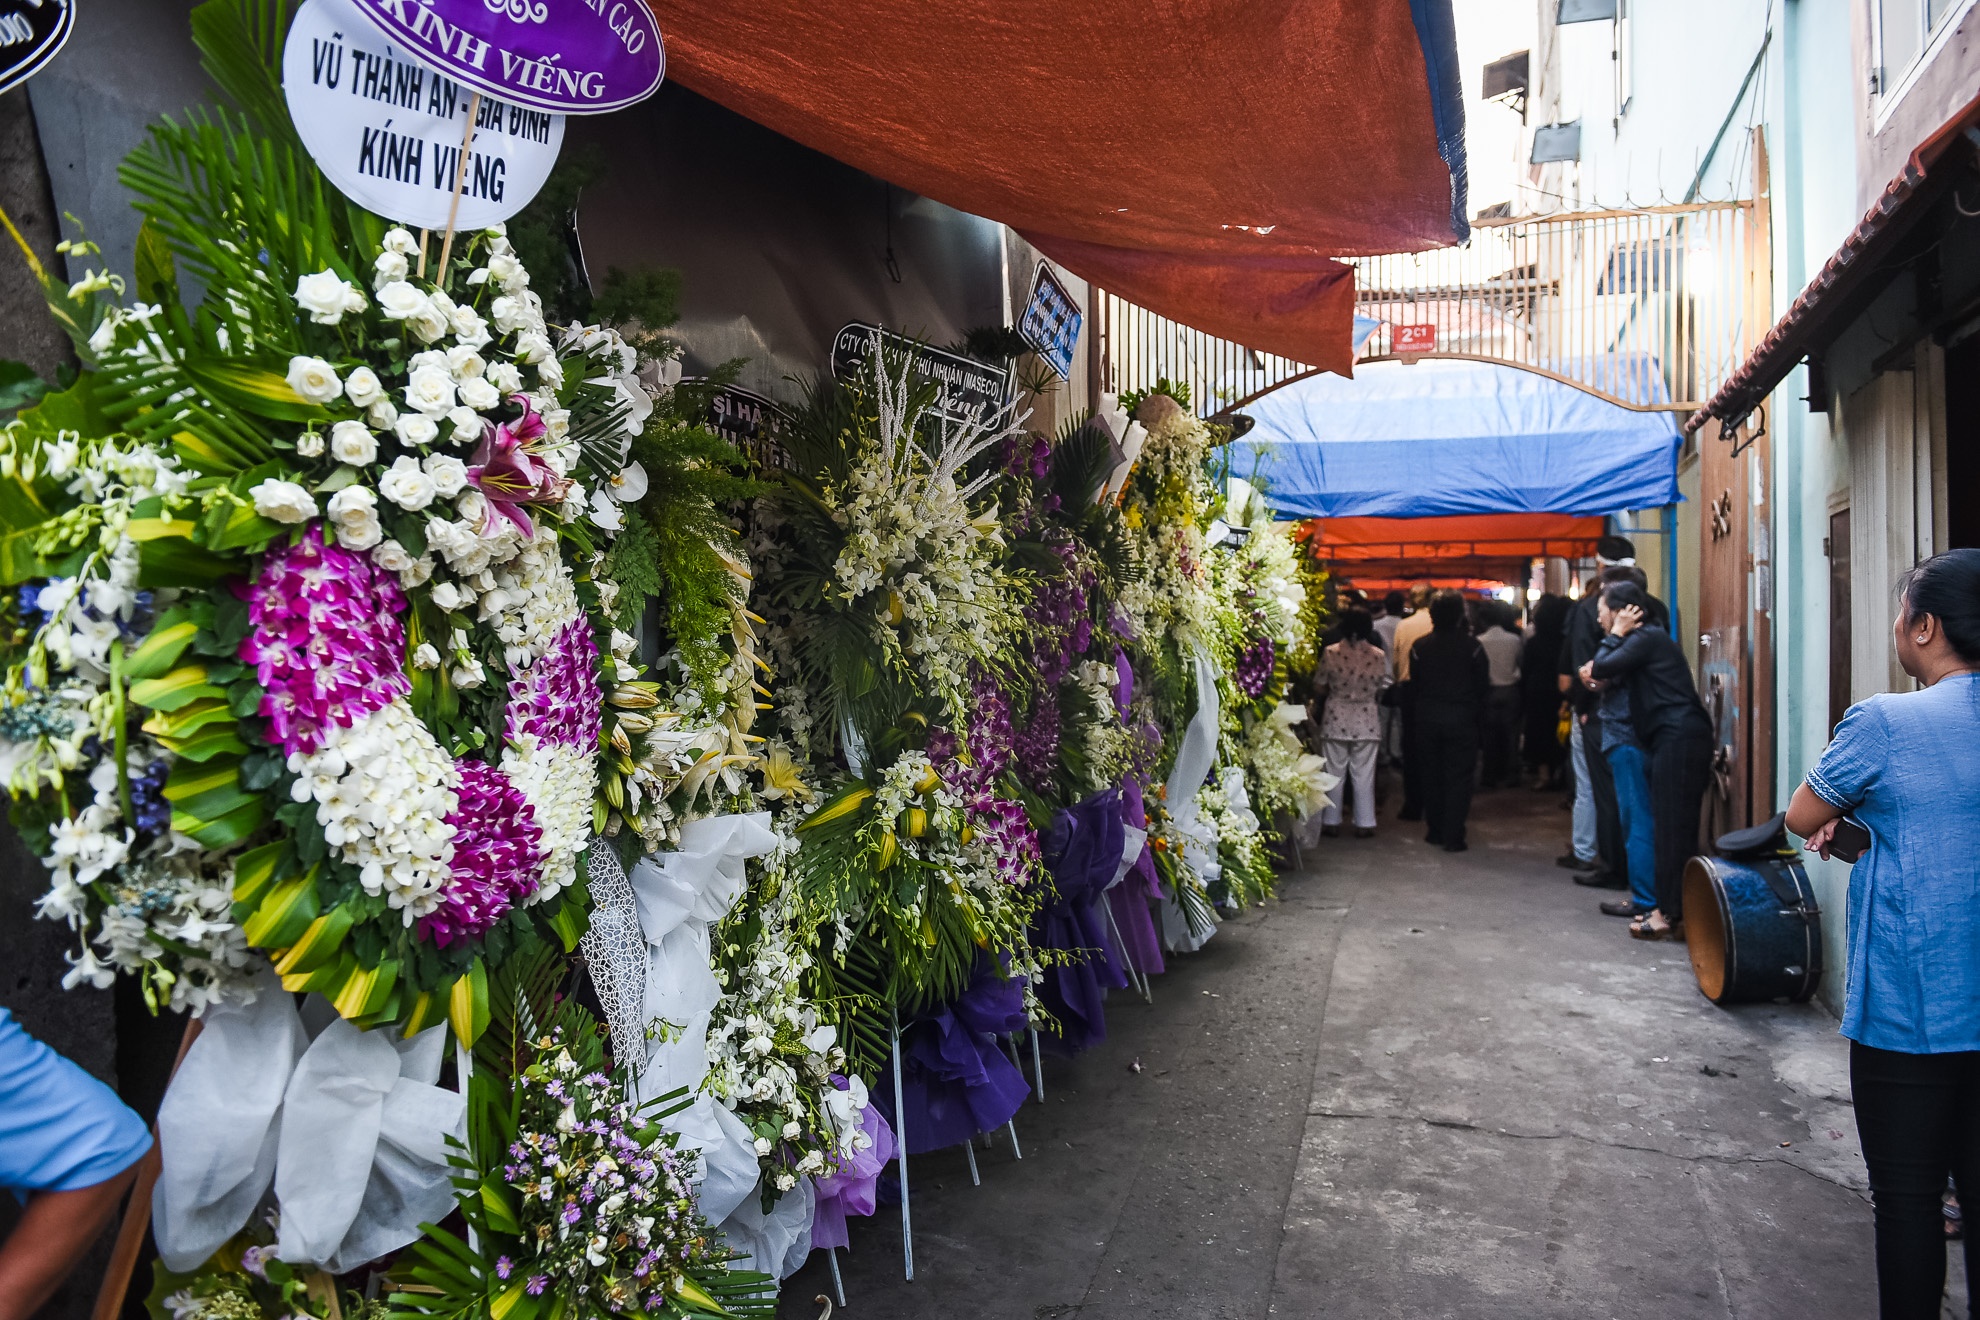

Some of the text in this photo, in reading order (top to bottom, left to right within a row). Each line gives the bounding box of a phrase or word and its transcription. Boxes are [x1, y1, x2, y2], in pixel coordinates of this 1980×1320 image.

[608, 2, 645, 55] CAO
[313, 31, 343, 89] VŨ
[351, 45, 424, 111] THÀNH
[427, 72, 458, 120] AN
[499, 48, 606, 99] VIẾNG
[358, 118, 424, 185] KÍNH
[840, 332, 861, 353] CTY
